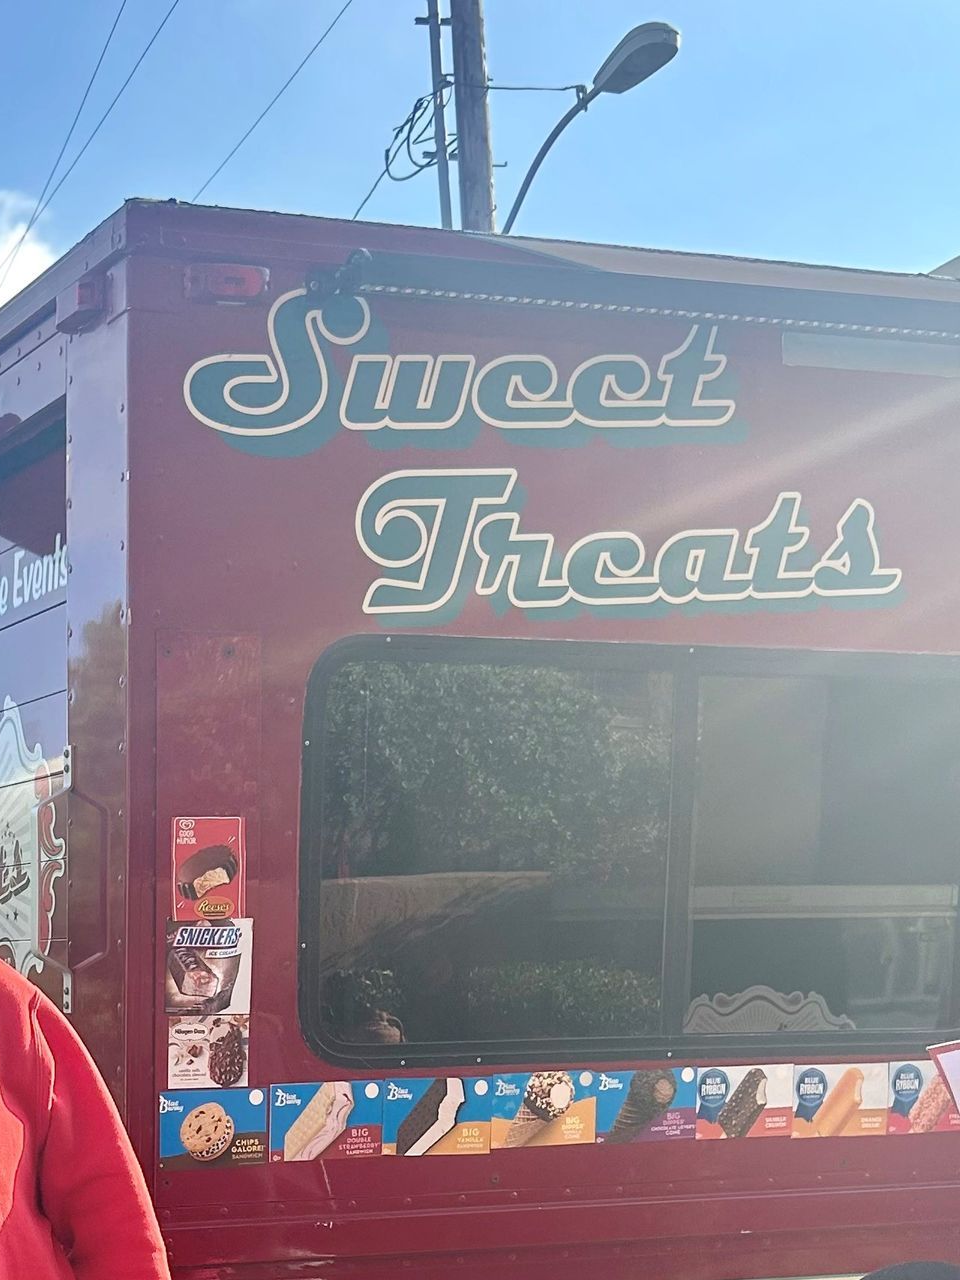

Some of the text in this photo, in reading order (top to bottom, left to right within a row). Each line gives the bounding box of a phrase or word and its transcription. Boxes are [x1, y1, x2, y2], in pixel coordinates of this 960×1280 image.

[184, 287, 737, 438] Sweet
[356, 467, 902, 614] Treats
[12, 532, 67, 608] Events
[176, 928, 240, 946] SNICKERS
[566, 1116, 580, 1124] BIG
[667, 1112, 680, 1120] BIG
[351, 1129, 368, 1137] BIG
[463, 1128, 479, 1136] BIG
